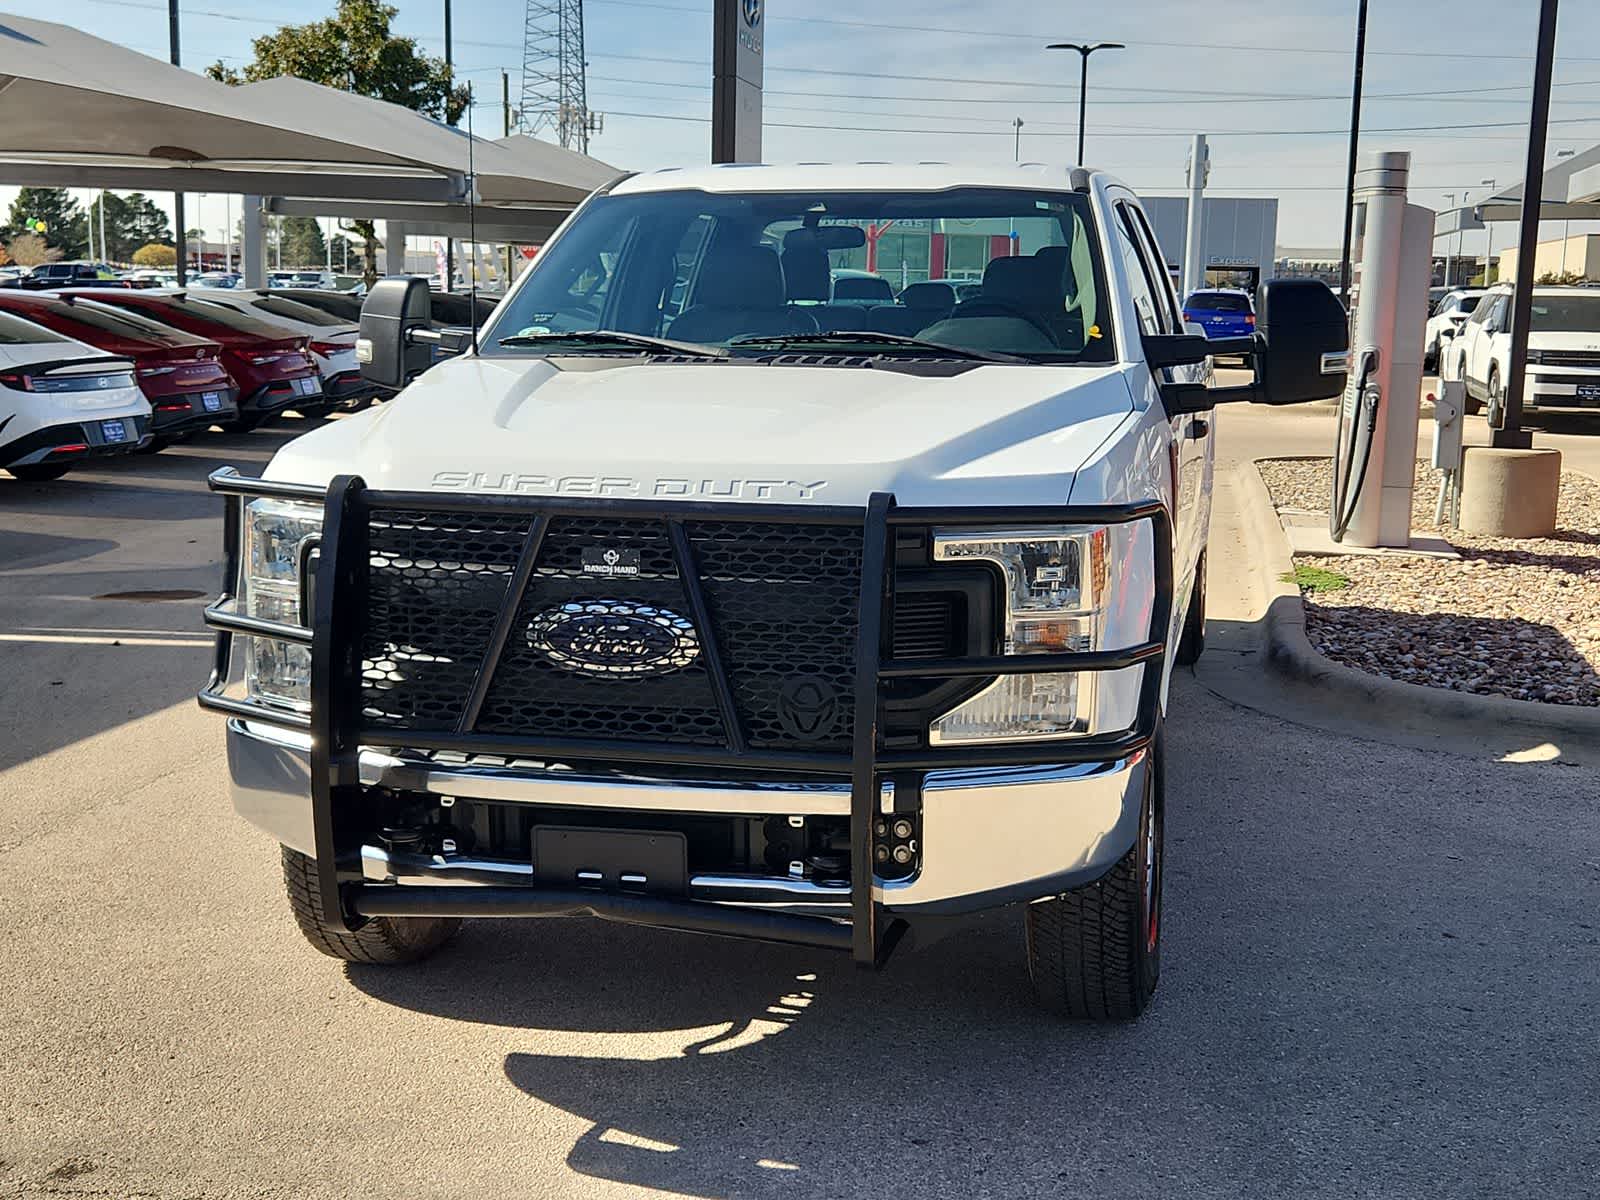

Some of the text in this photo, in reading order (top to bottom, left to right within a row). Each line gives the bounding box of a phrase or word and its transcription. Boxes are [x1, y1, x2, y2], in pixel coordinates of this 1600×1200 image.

[431, 471, 829, 500] SUPER DUTY
[584, 564, 638, 574] RANCH HAND
